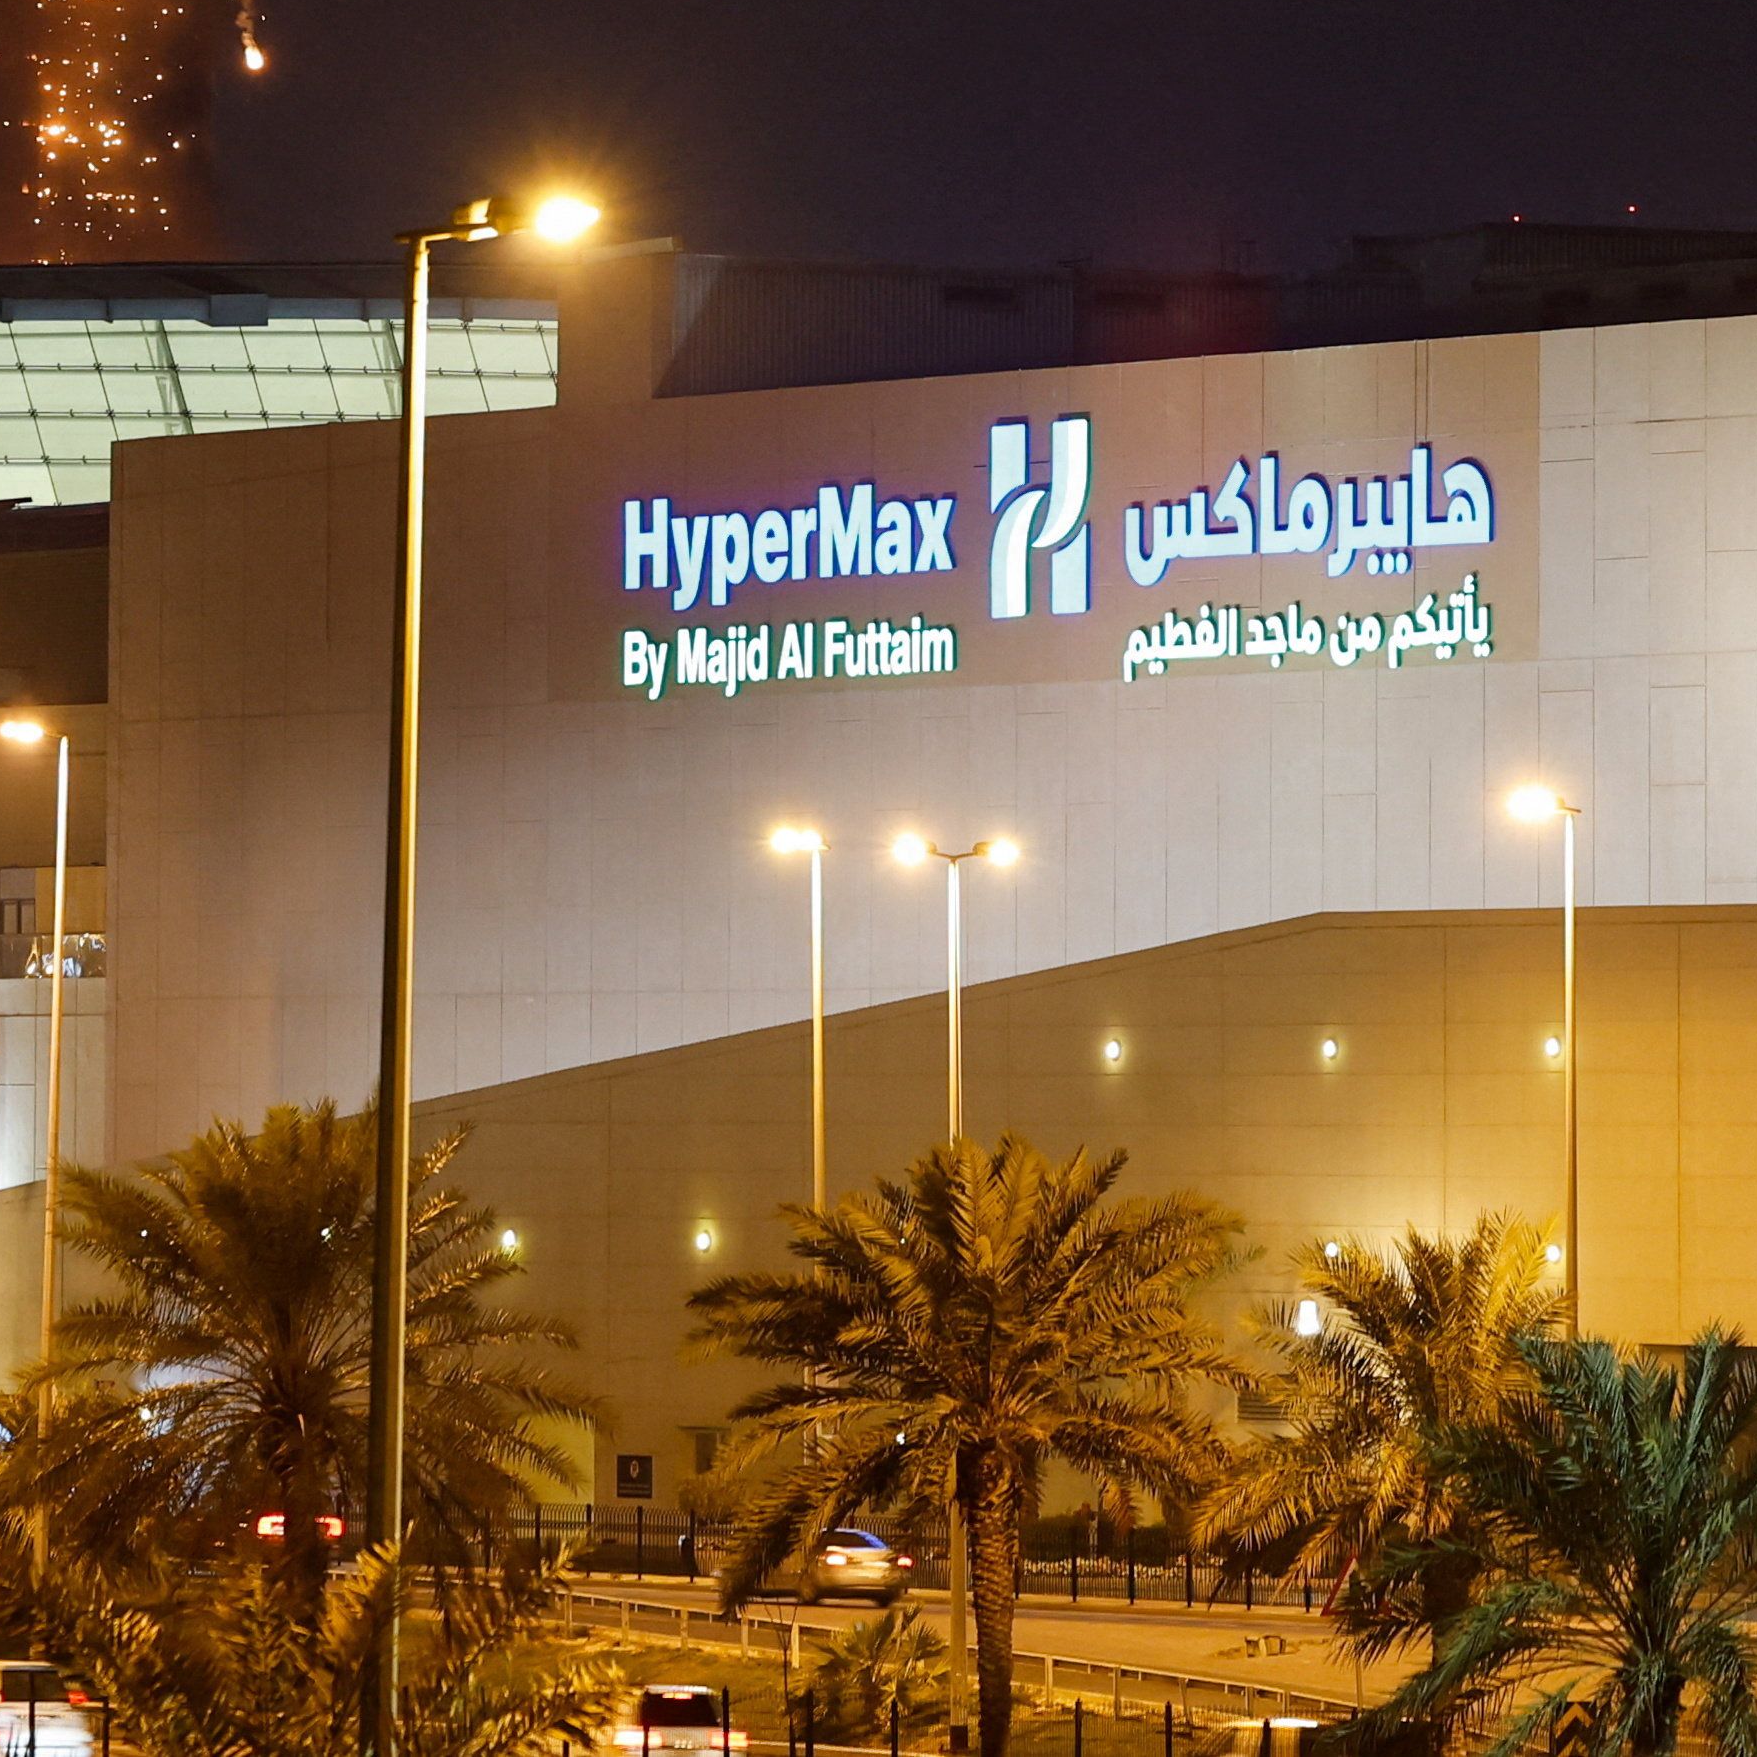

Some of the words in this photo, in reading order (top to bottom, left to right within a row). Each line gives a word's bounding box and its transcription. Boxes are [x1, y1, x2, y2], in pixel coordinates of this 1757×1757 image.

[624, 483, 953, 611] HyperMax
[1124, 448, 1491, 586] هايبرماكس
[623, 630, 668, 701] By
[677, 624, 768, 698] Majid
[777, 622, 814, 680] Al
[824, 616, 954, 678] Futtaim
[1122, 603, 1240, 683] الفطيم
[1244, 603, 1324, 668] ماجد
[1328, 613, 1382, 667] من
[1387, 574, 1492, 669] يأتيكم
